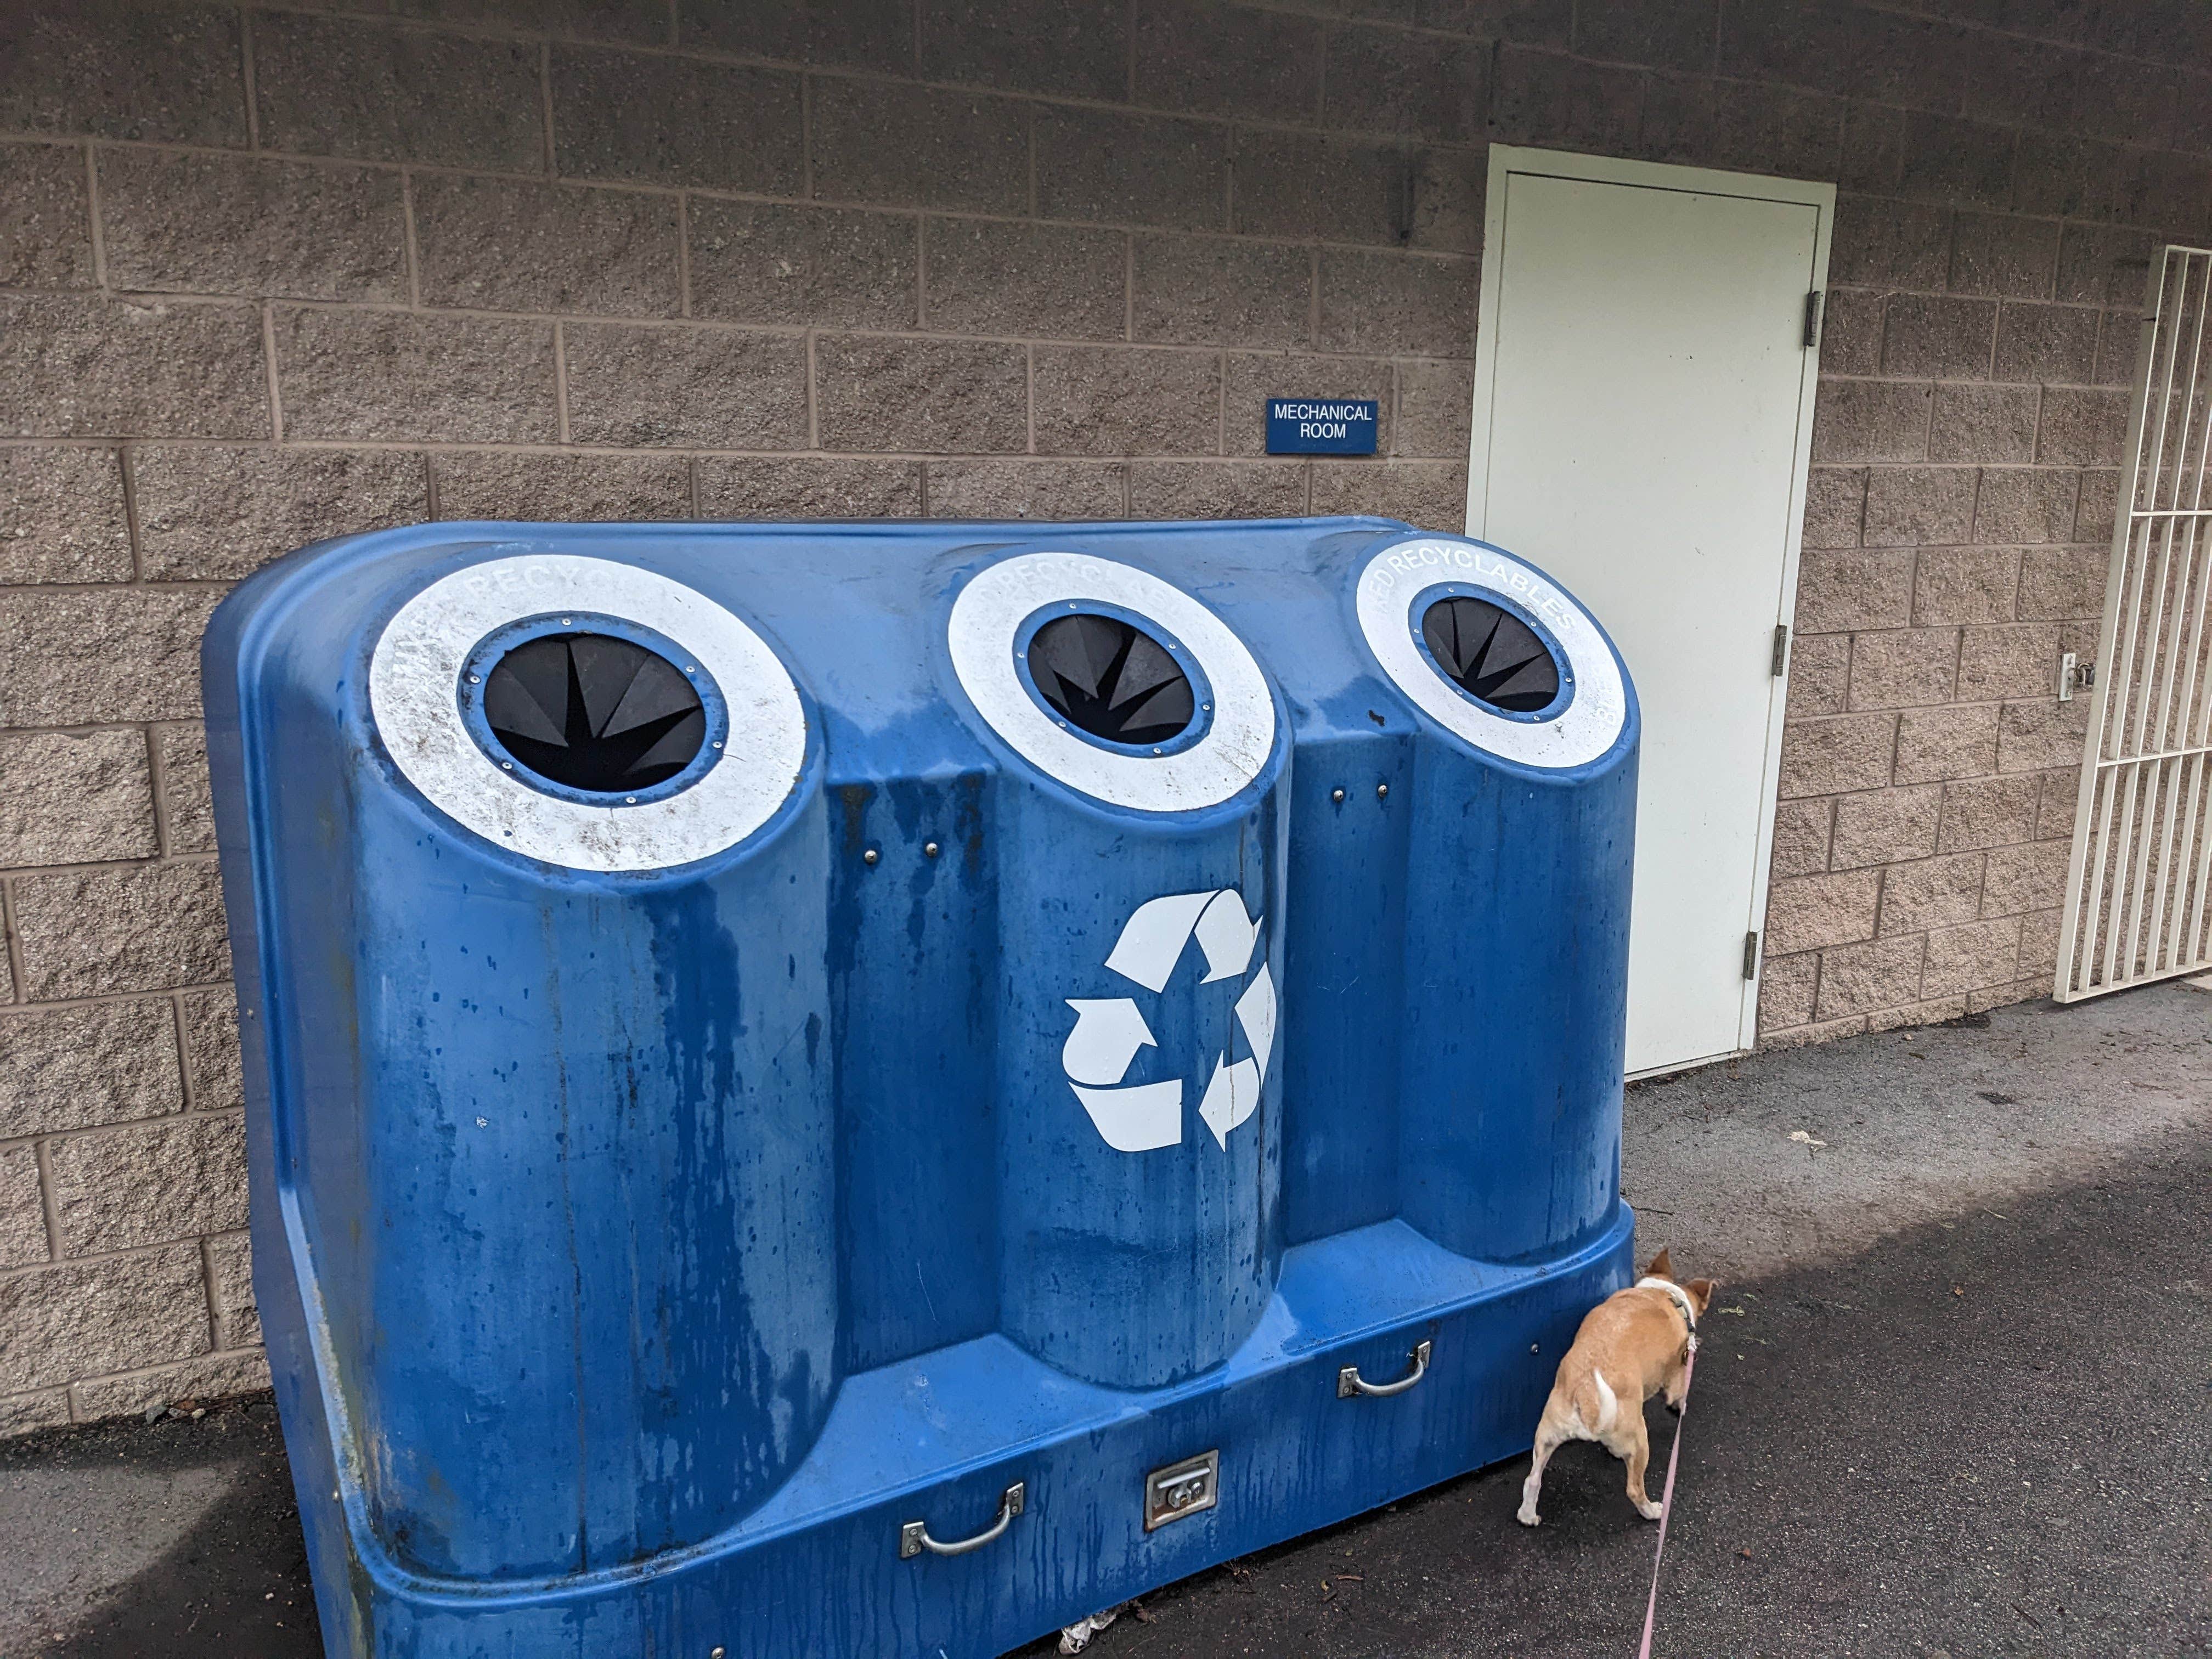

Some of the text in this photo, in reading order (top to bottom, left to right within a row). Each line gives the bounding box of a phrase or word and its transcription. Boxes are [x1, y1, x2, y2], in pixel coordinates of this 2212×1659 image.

[1274, 404, 1372, 421] MECHANICAL
[1300, 422, 1346, 438] ROOM
[1386, 546, 1576, 630] RECYCLABLES
